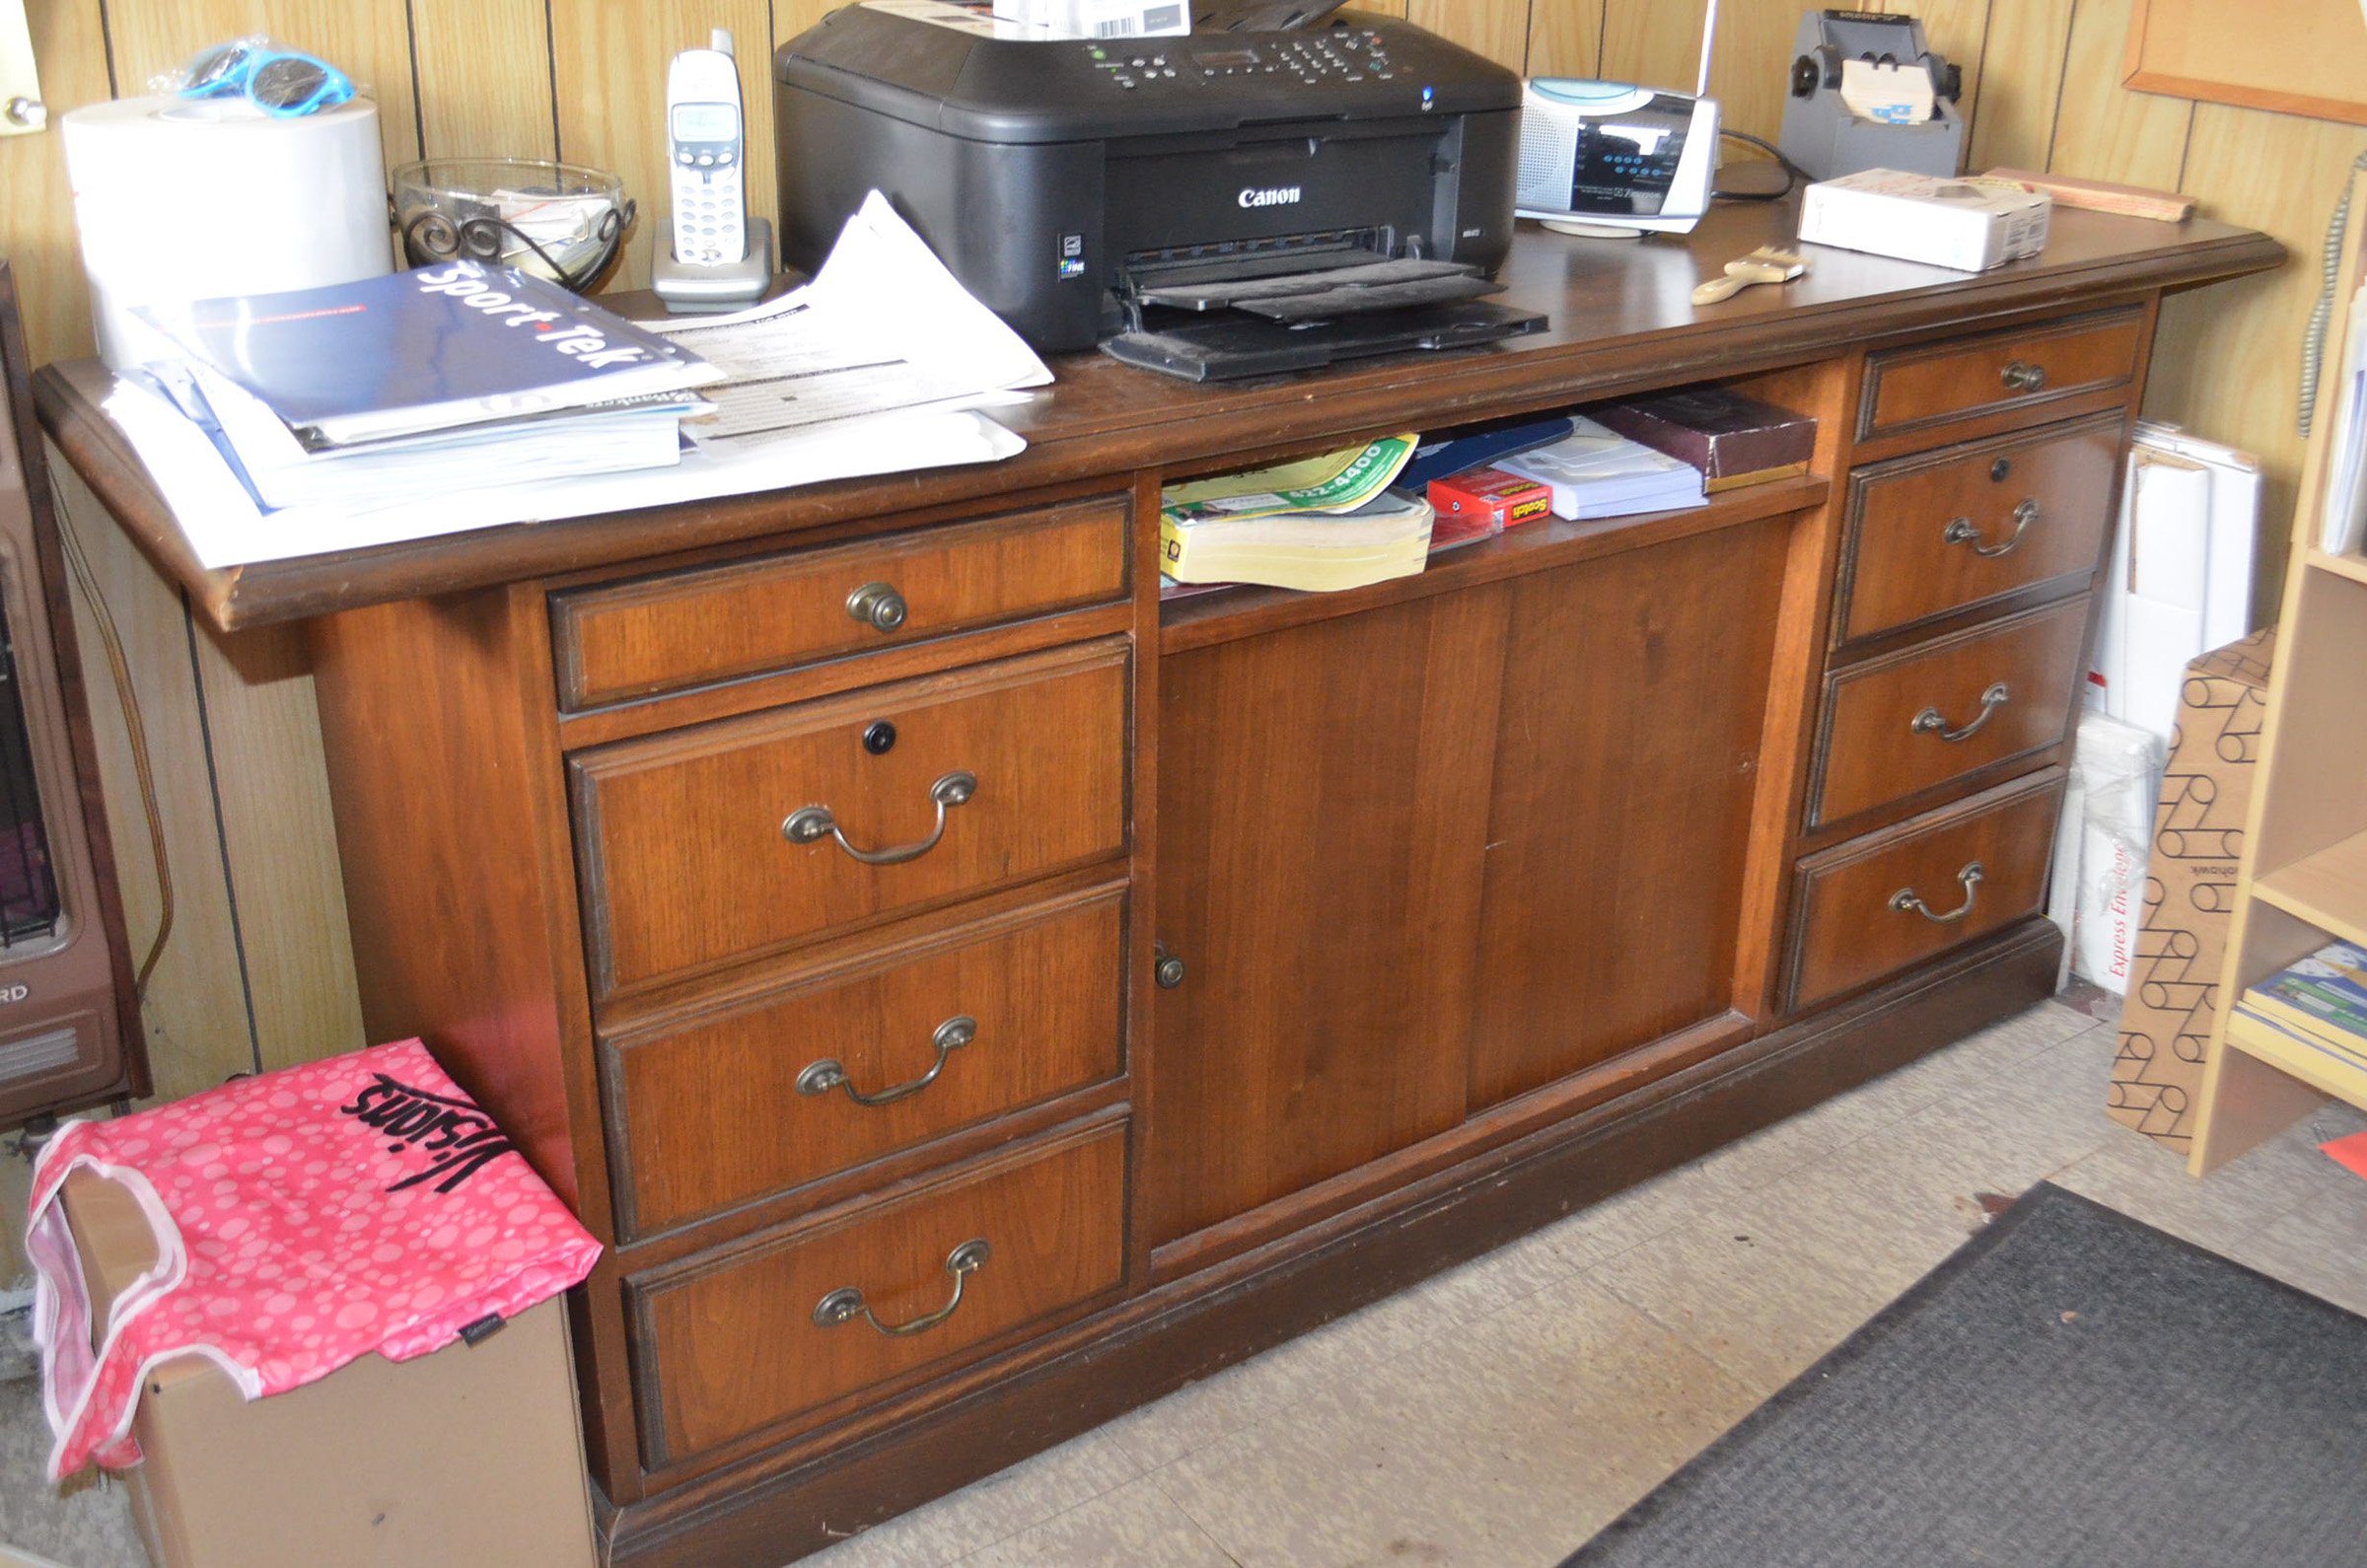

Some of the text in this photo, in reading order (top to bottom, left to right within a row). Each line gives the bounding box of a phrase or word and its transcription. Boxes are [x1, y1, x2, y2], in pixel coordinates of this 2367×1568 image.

[1238, 186, 1301, 208] Canon
[1513, 497, 1547, 520] Scotch
[2190, 866, 2238, 878] ohawk
[2109, 918, 2129, 978] Express
